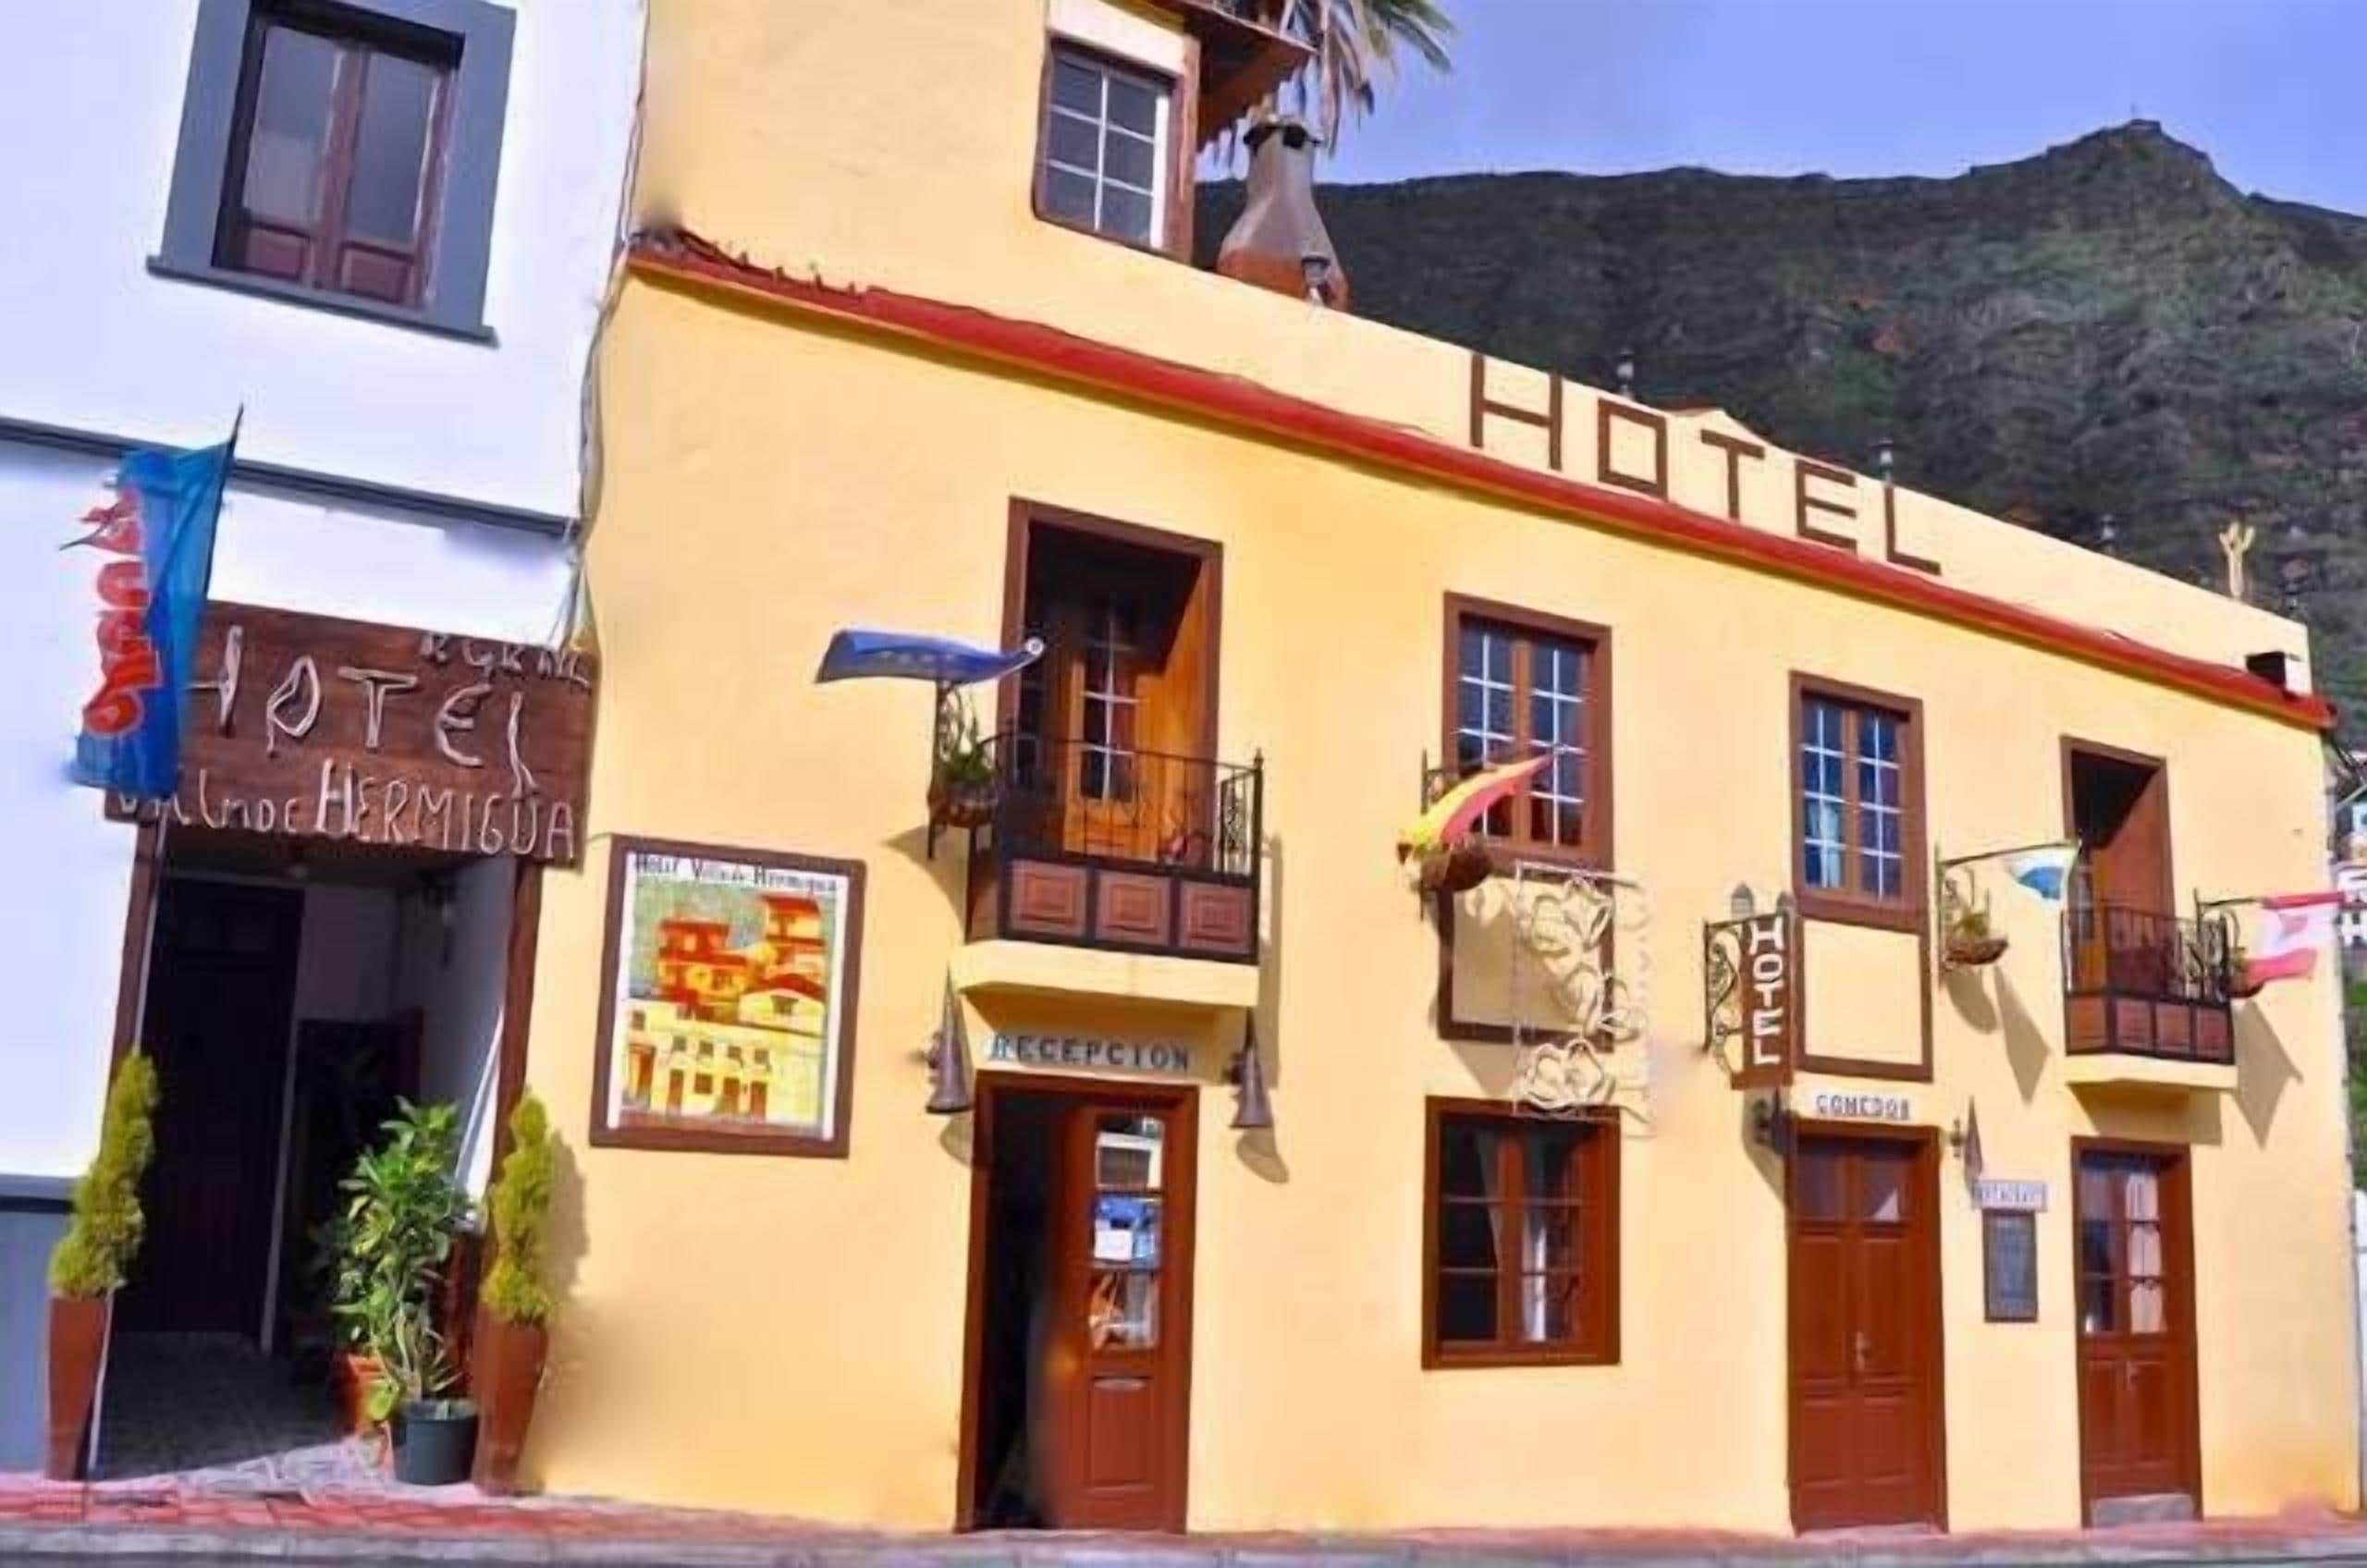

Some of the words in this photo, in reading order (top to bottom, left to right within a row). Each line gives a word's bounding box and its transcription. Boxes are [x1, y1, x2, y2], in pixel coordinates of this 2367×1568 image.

[1470, 353, 1941, 575] HOTEL
[314, 758, 575, 861] HERMIGUA
[1749, 915, 1785, 1064] HOTEL
